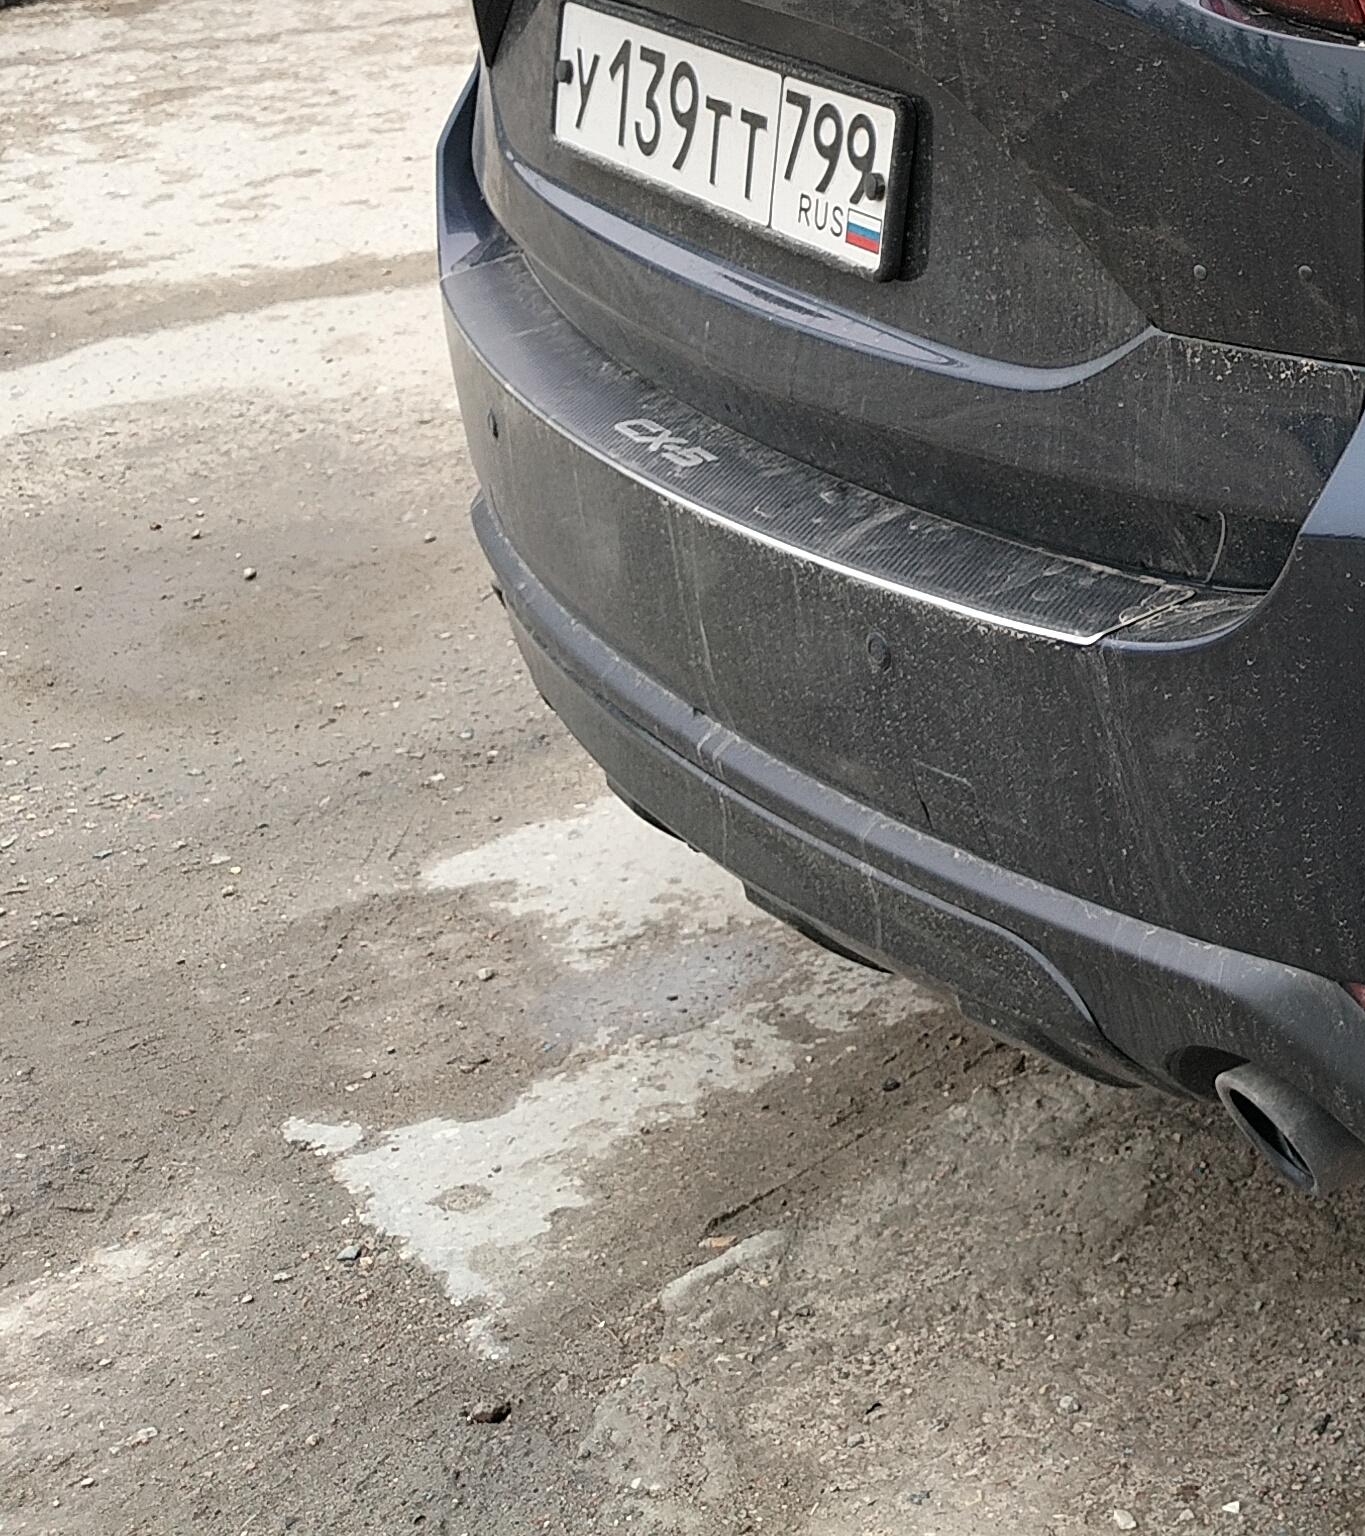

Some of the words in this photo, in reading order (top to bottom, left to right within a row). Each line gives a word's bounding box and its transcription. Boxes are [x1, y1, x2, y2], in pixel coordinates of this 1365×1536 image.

[783, 88, 878, 206] 799
[797, 193, 846, 238] RUS
[613, 418, 719, 468] CX-5
